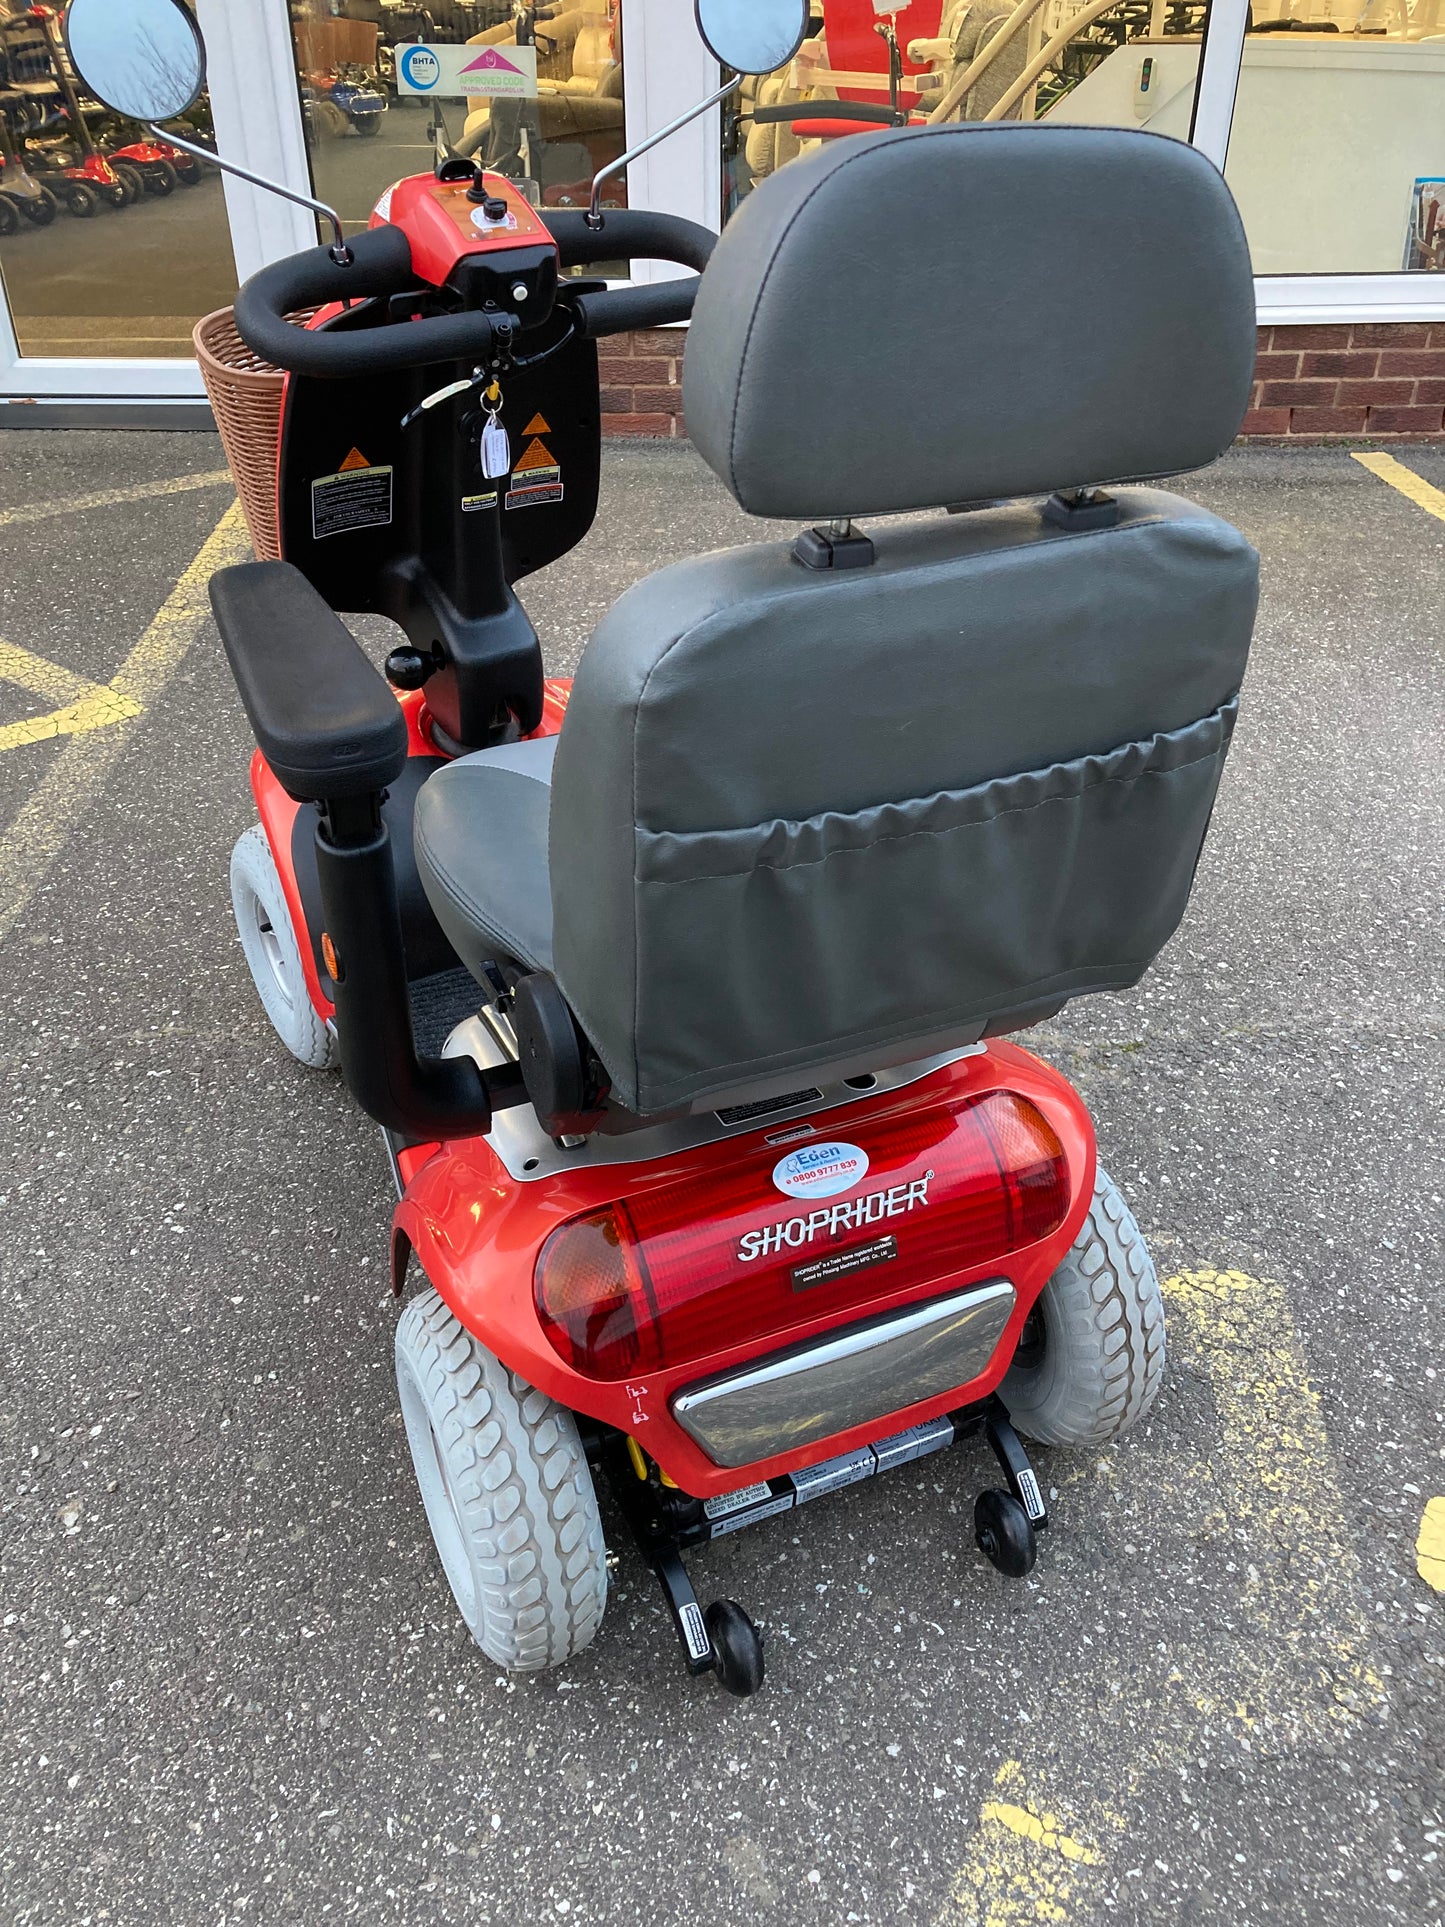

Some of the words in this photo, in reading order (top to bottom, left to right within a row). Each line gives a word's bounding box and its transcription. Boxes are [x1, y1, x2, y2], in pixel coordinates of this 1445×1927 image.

[412, 57, 435, 65] BHTA
[459, 76, 502, 86] APPROVED
[504, 76, 525, 86] CODE
[796, 1146, 840, 1165] Eden
[793, 1171, 817, 1183] 0800
[817, 1164, 838, 1176] 9777
[840, 1159, 857, 1170] 839
[854, 1247, 873, 1258] registered
[874, 1241, 892, 1251] worldwide
[802, 1274, 816, 1282] owned
[840, 1260, 859, 1270] Machinery
[706, 1496, 735, 1510] ADJUSTED
[736, 1491, 745, 1499] BY
[727, 1497, 750, 1508] DEALER
